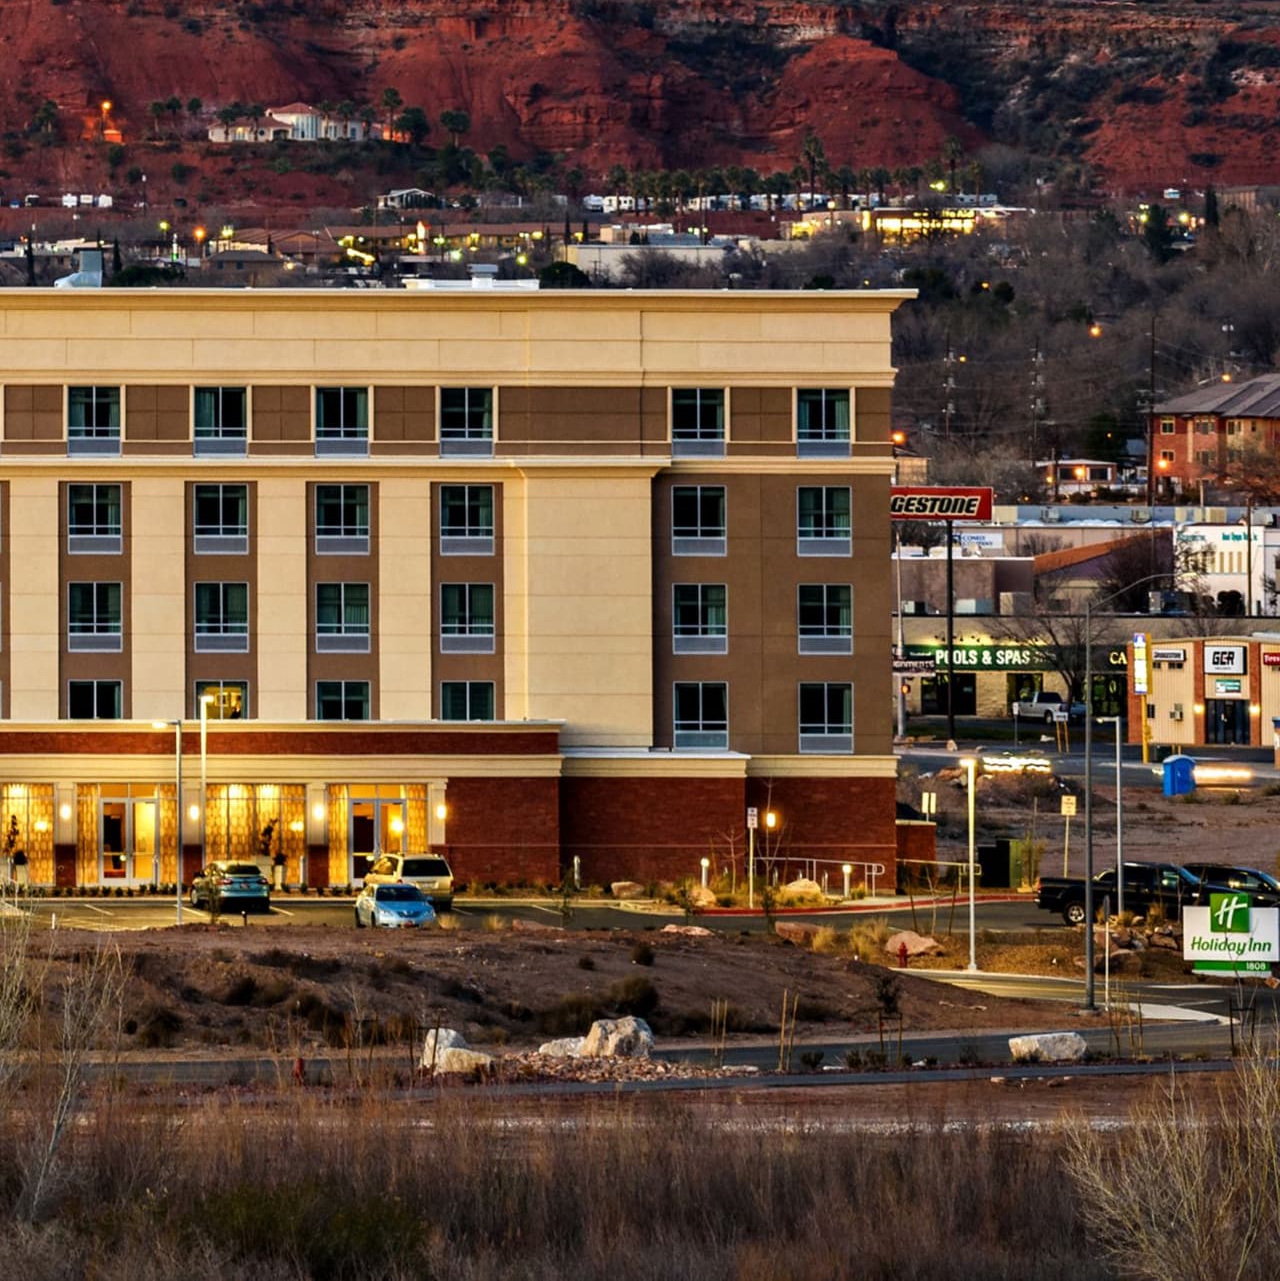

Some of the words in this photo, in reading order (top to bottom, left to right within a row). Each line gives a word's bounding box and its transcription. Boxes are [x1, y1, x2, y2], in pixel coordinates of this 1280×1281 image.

[891, 496, 980, 515] GESTONE
[981, 649, 993, 665] &
[996, 649, 1031, 665] SPAS
[1191, 936, 1246, 956] Holiday
[1248, 936, 1272, 952] Inn
[1246, 961, 1266, 970] 1808
